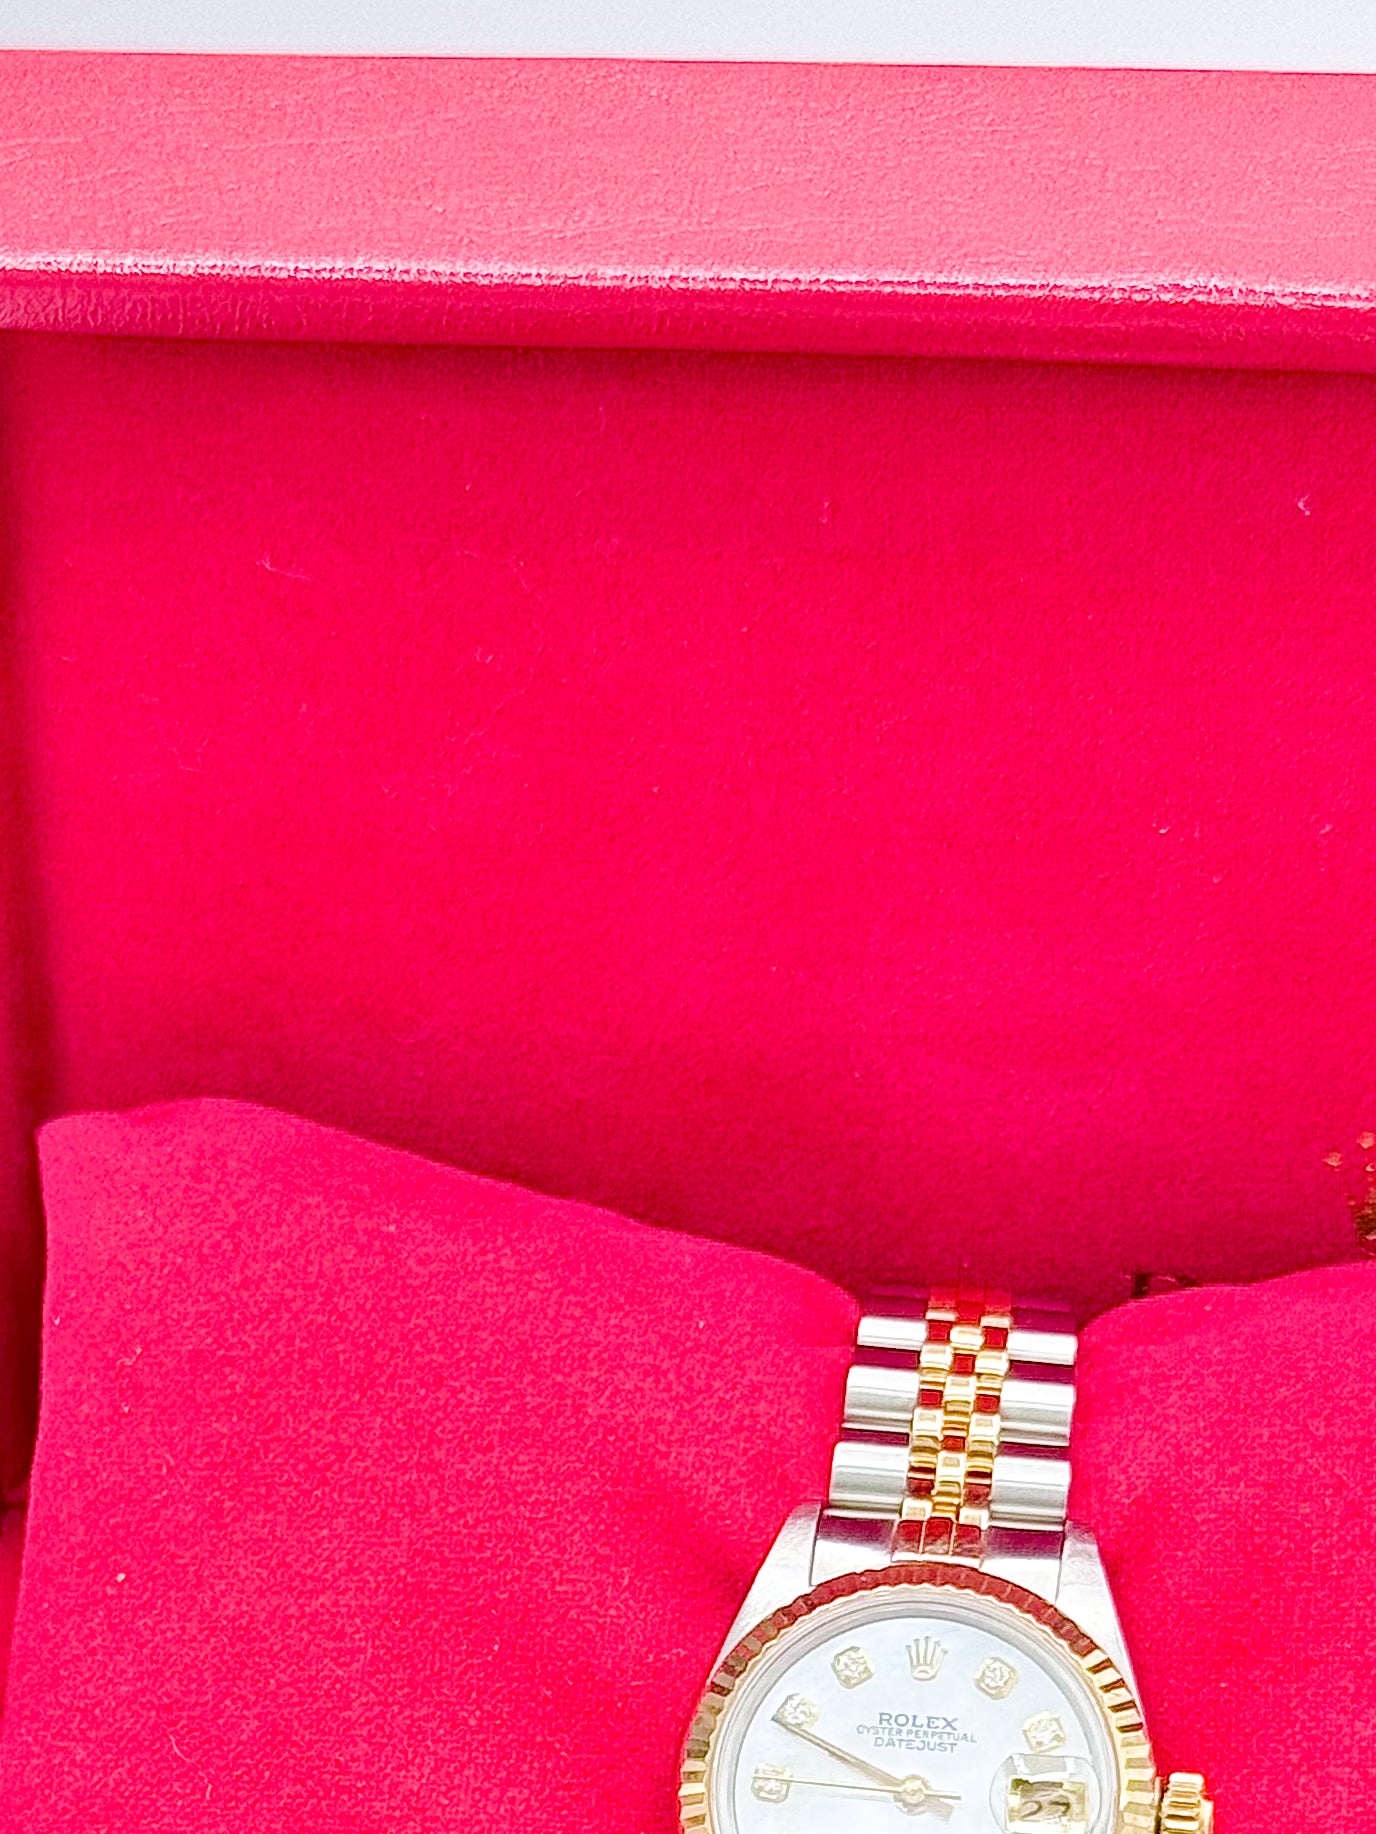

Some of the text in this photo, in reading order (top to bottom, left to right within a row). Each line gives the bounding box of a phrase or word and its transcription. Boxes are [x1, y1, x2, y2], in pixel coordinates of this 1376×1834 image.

[878, 1712, 960, 1731] ROLEX
[856, 1724, 978, 1743] OYSTER PERPETUAL
[873, 1736, 958, 1754] DATEJUST
